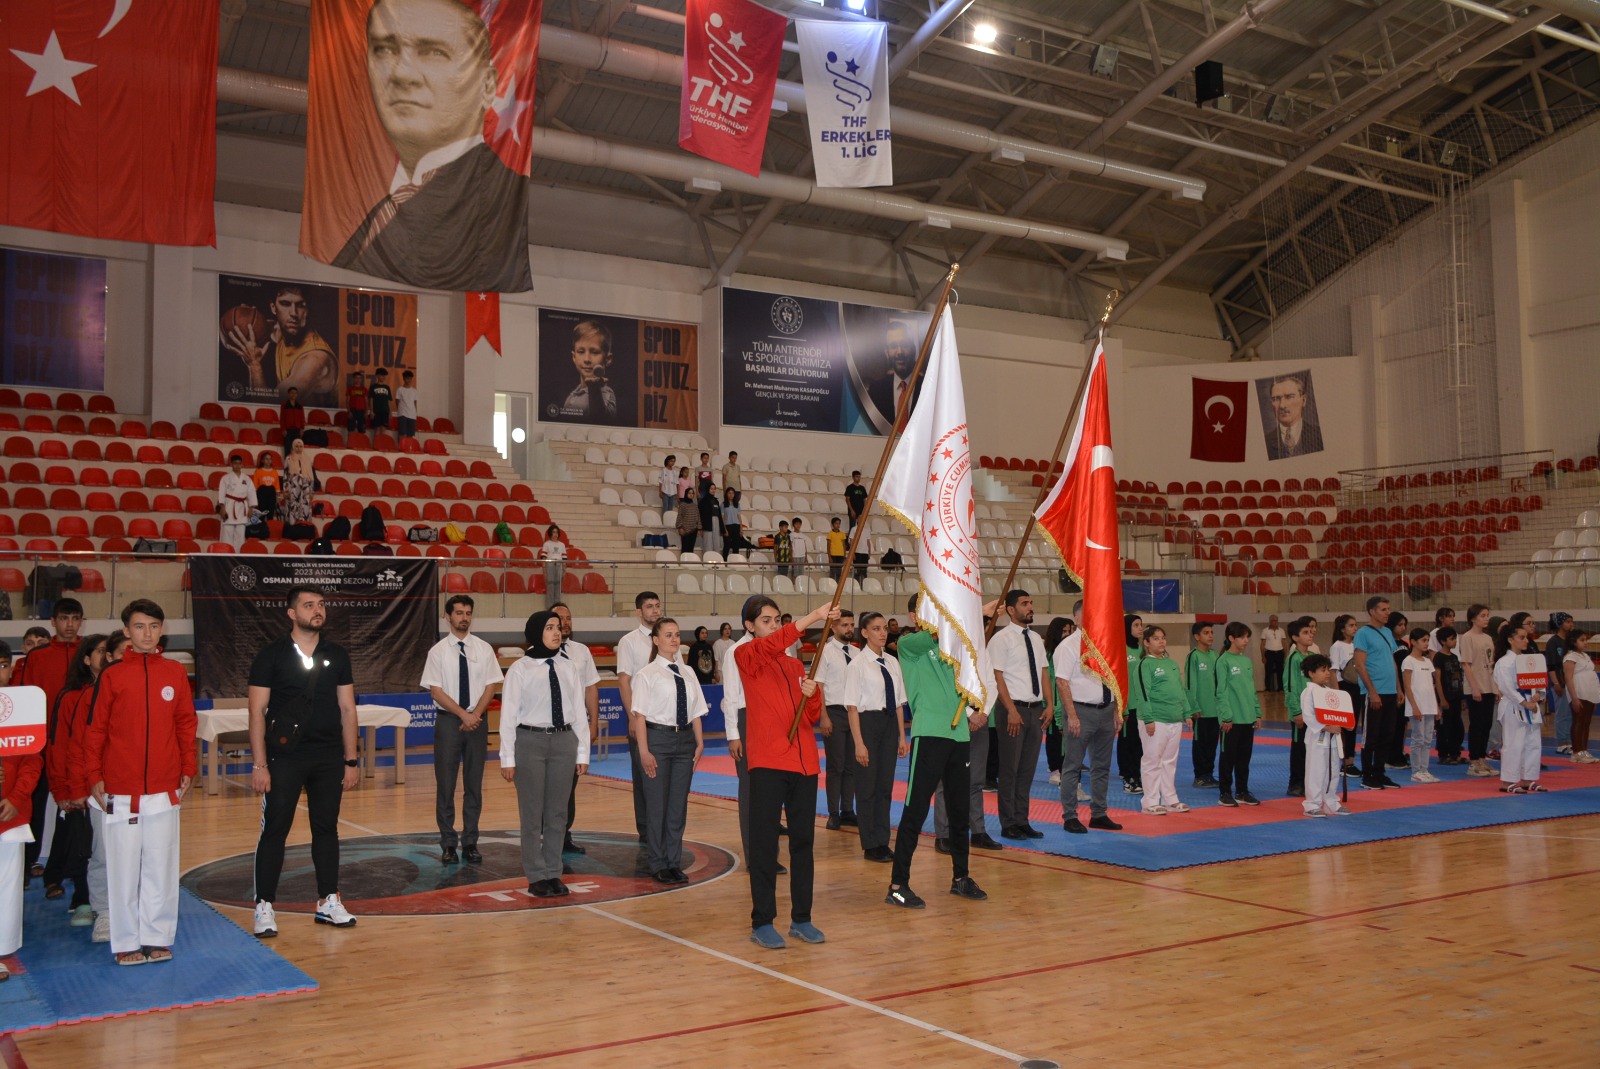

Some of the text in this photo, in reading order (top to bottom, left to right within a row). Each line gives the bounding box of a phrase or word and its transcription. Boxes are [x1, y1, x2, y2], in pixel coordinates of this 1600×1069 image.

[690, 76, 752, 117] THF
[718, 114, 748, 132] Hentbol
[842, 116, 867, 127] THF
[821, 129, 891, 143] ERKEKLER
[841, 142, 877, 158] 1. LİG
[347, 292, 395, 328] SPOR
[644, 325, 680, 356] SPOR
[752, 341, 821, 357] TÜM ANTRENÖR
[742, 351, 831, 369] VE SPORCULARIMIZA
[745, 363, 829, 379] BAŞARILAR DİLİYORUM
[755, 390, 778, 399] GENÇLİK
[800, 394, 820, 402] BAKANI
[800, 387, 829, 395] KASAPOĞLU
[644, 392, 667, 423] BİZ
[943, 482, 956, 531] TÜRKİYE
[1519, 677, 1546, 686] DİYARBAKIR
[1323, 713, 1348, 723] BATMAN
[468, 881, 600, 901] TF
